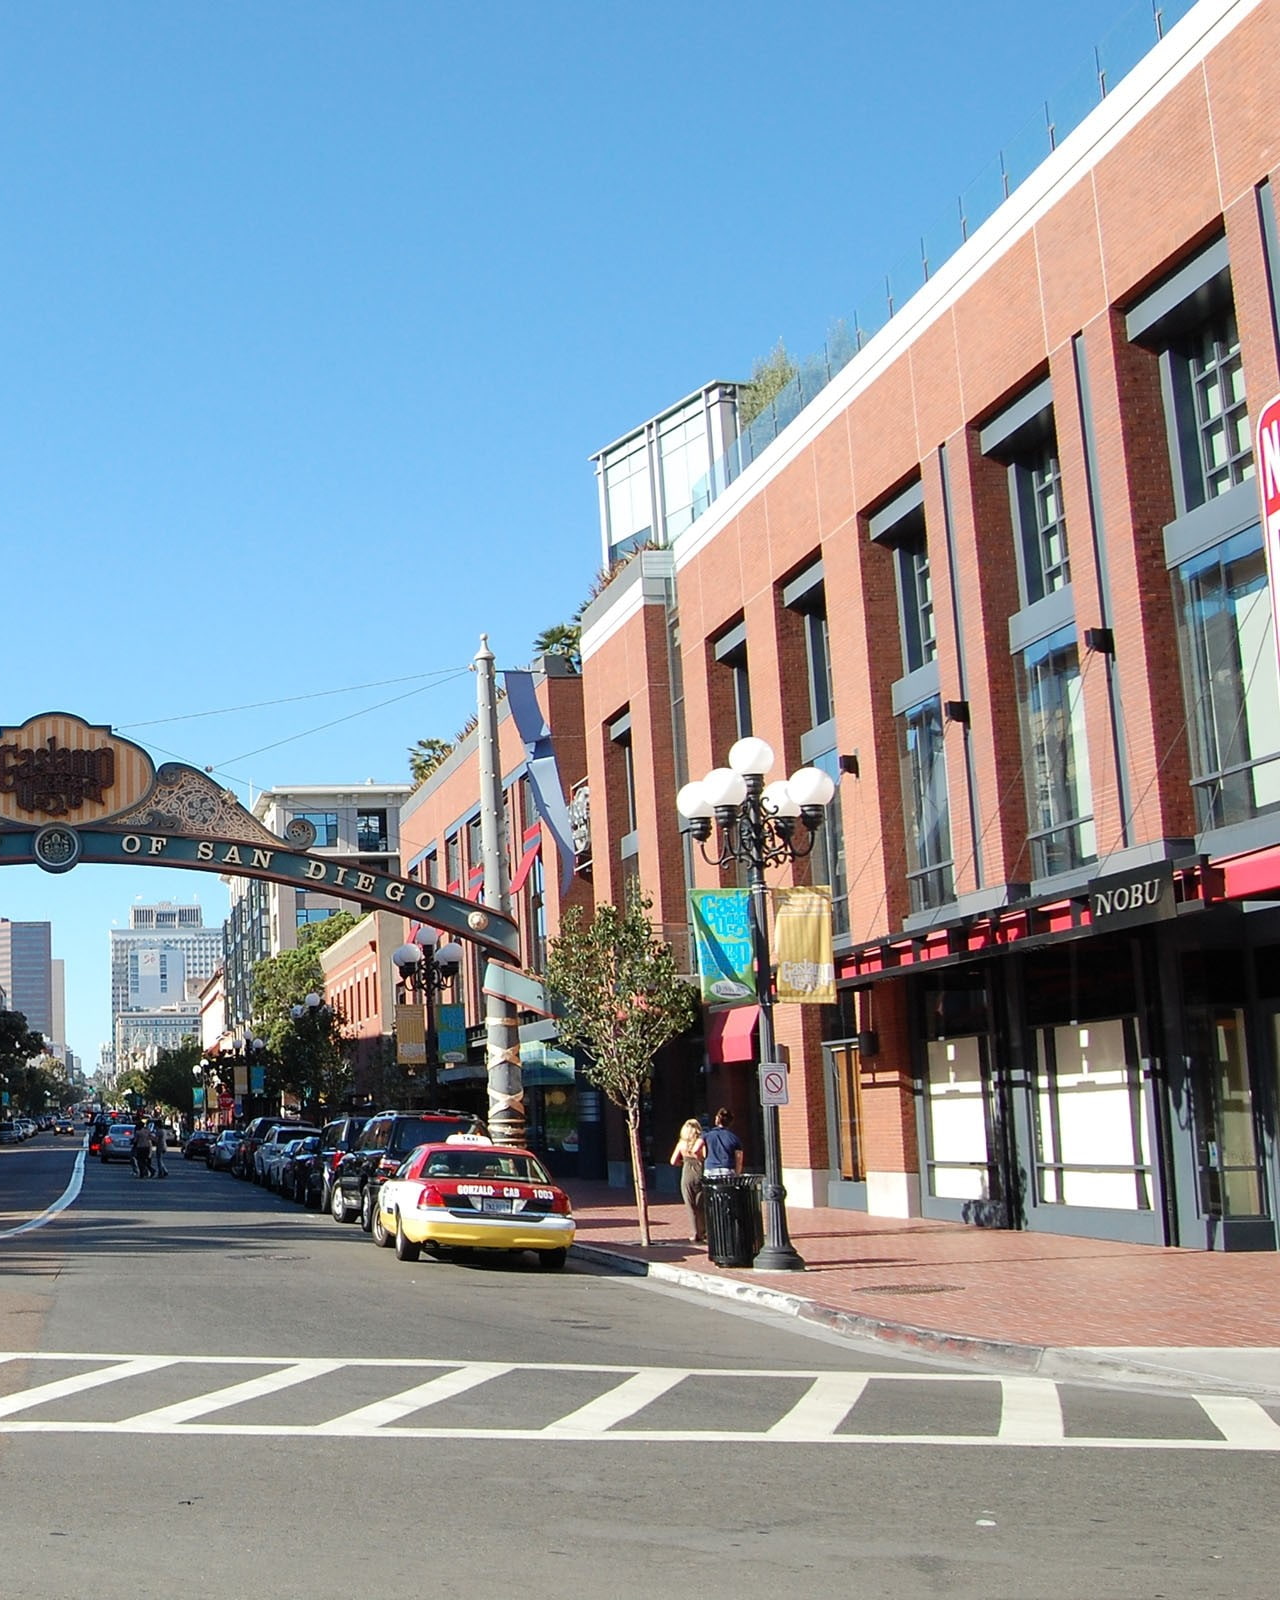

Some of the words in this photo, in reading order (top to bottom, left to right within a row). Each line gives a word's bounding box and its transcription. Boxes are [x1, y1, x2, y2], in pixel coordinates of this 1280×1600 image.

[122, 835, 167, 855] OF
[197, 841, 274, 869] SAN
[305, 859, 436, 911] DIEGO
[1094, 878, 1160, 917] NOBU
[457, 1184, 493, 1196] GONZALO
[503, 1187, 520, 1198] CAB
